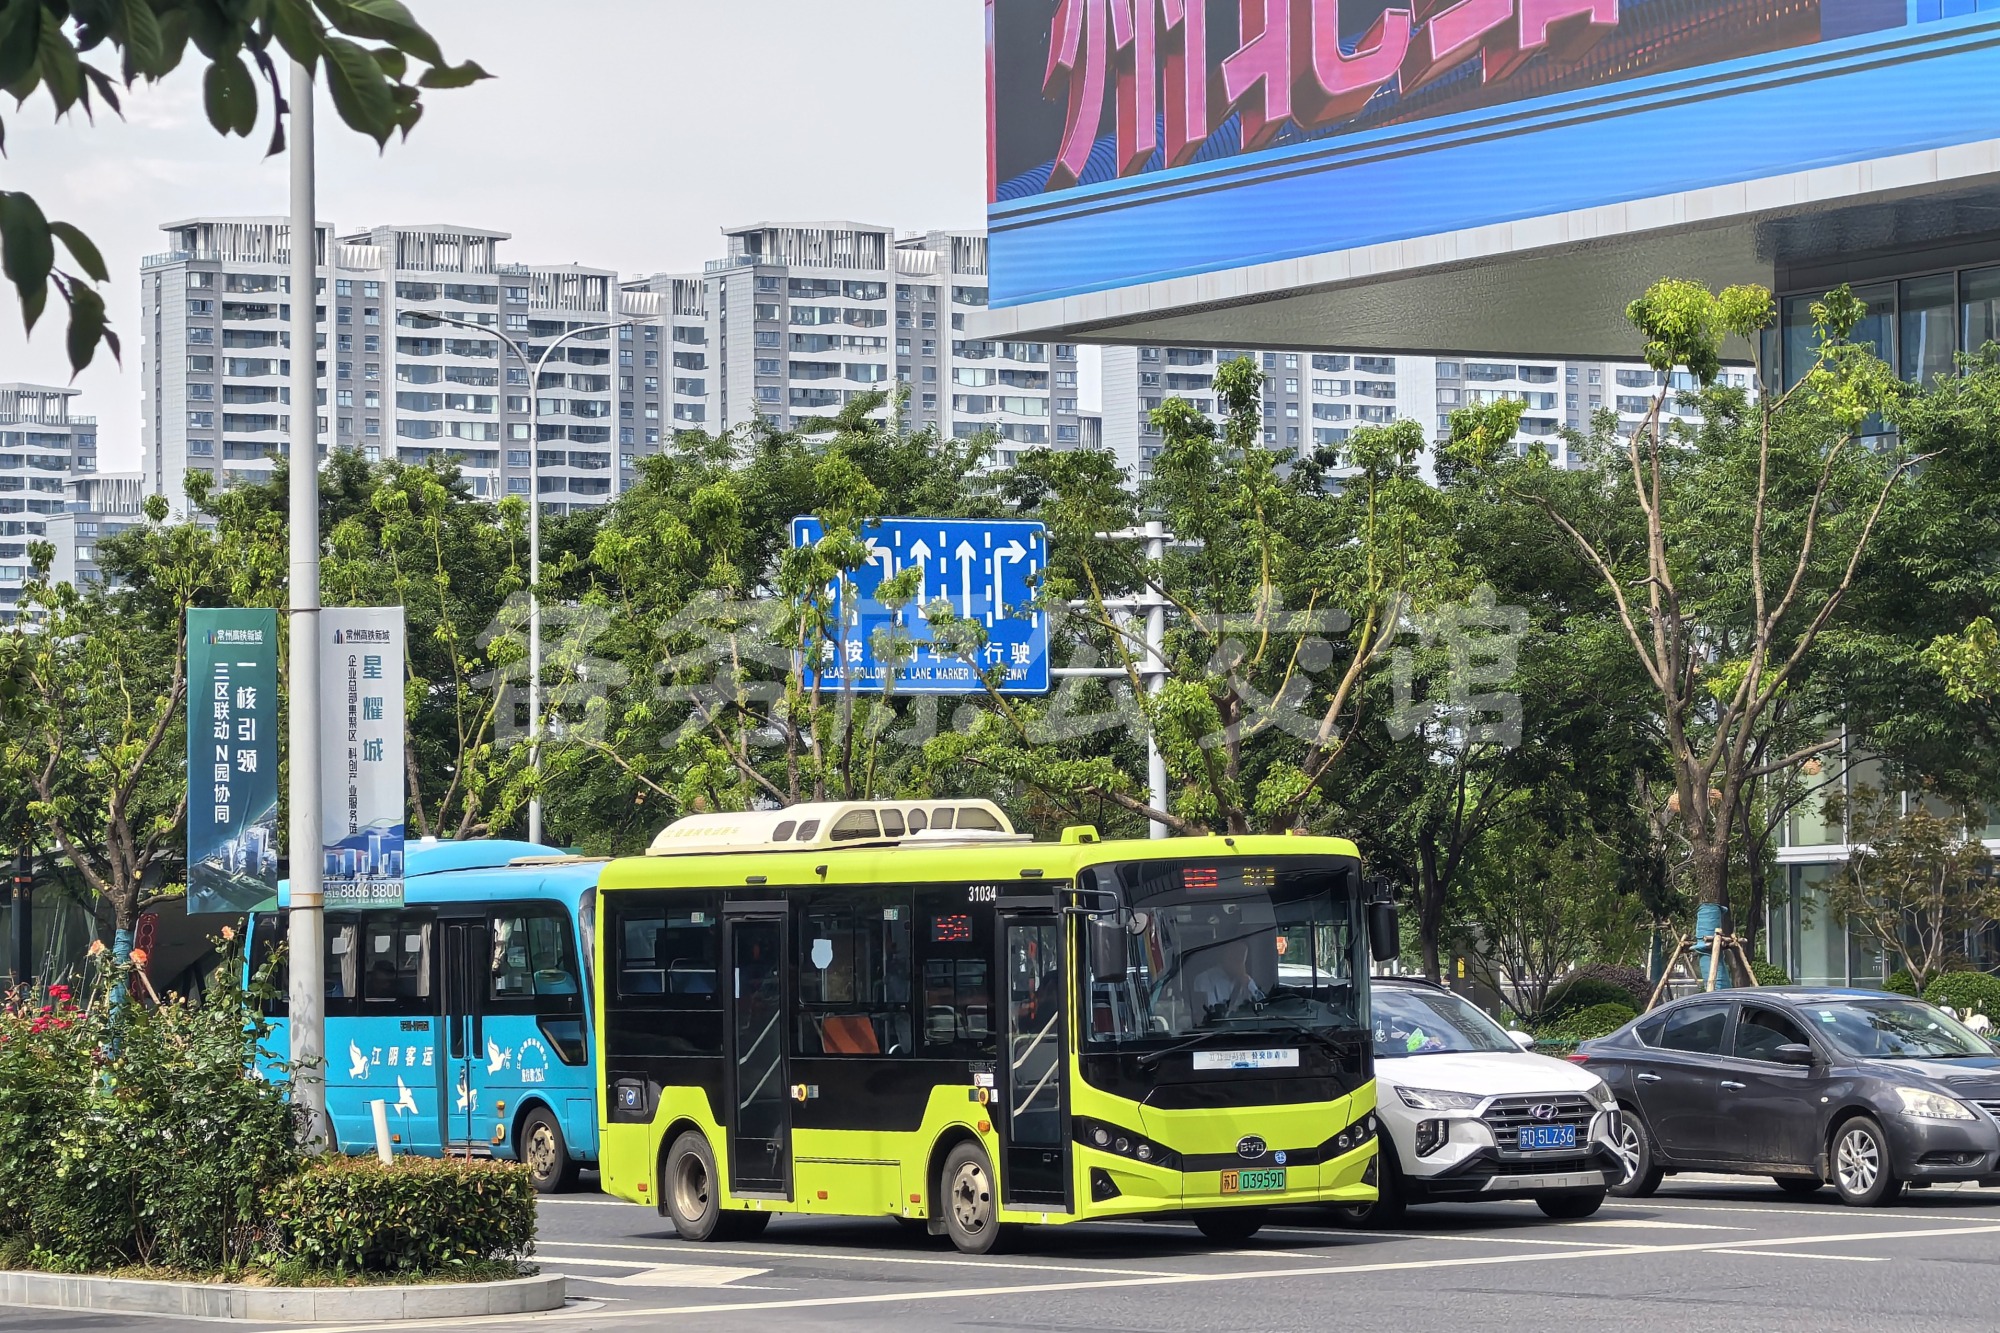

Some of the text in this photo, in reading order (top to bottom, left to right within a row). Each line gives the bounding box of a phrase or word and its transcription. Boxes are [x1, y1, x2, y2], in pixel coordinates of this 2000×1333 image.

[217, 629, 263, 642] 常州高铁新城
[345, 628, 390, 641] 常州高铁新城
[910, 667, 932, 680] LANE
[936, 667, 969, 680] MARKER
[362, 655, 384, 762] 星耀城
[236, 661, 257, 773] 一核引领
[340, 883, 369, 898] 8866
[372, 883, 401, 898] 8800
[968, 885, 997, 902] 31034
[371, 1046, 433, 1066] 江阴客运
[1239, 1141, 1264, 1152] BYD
